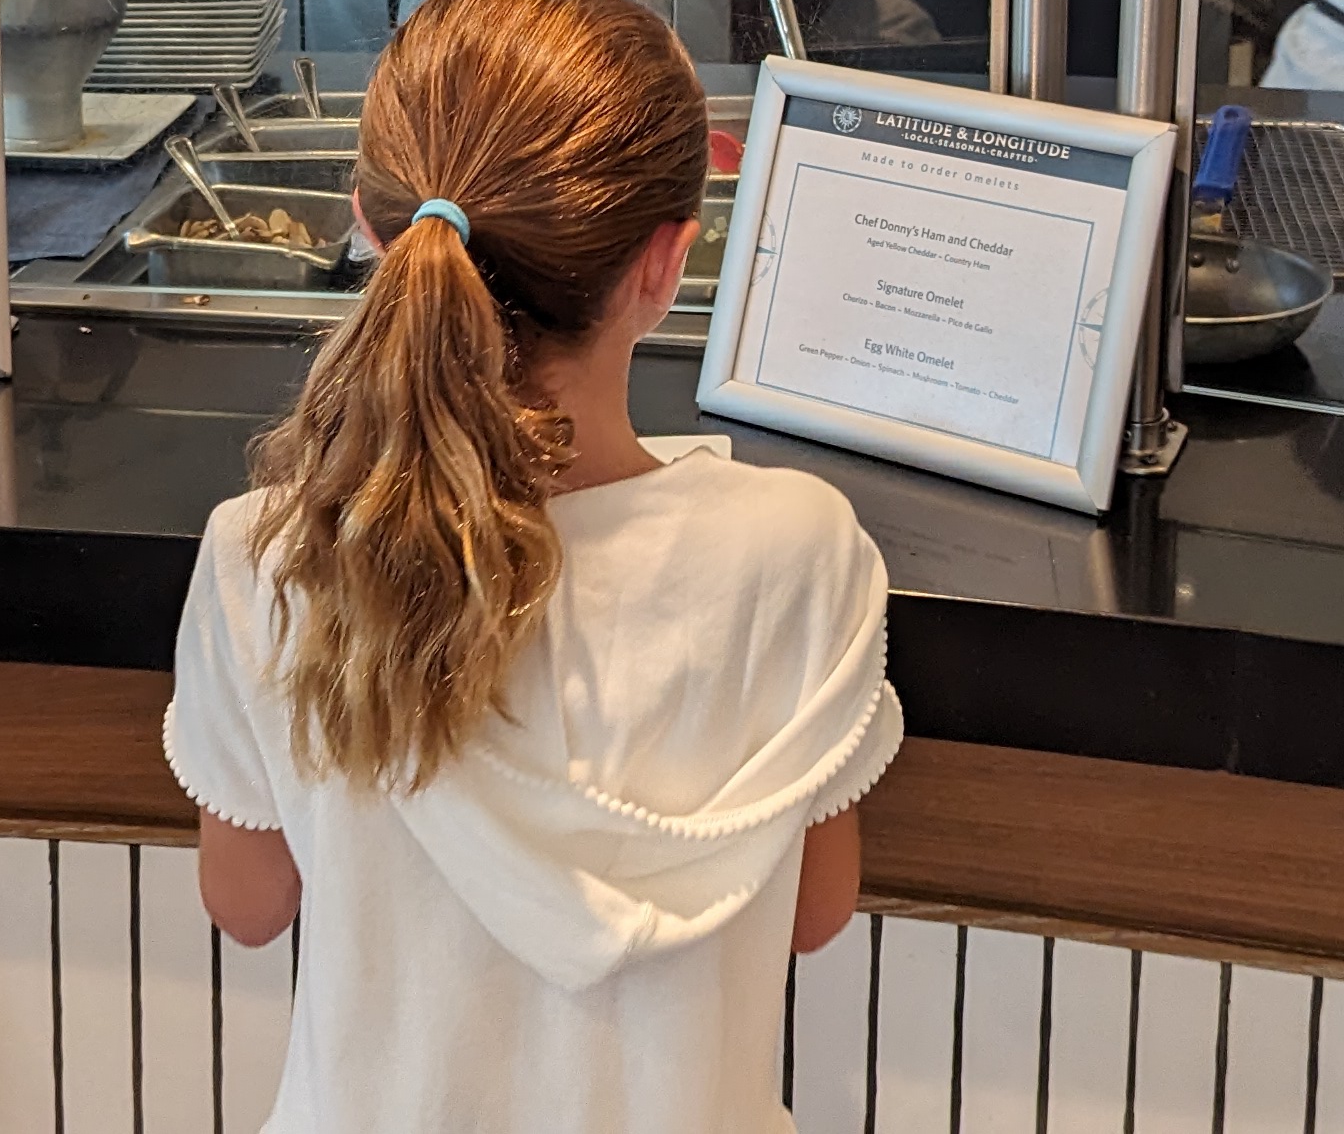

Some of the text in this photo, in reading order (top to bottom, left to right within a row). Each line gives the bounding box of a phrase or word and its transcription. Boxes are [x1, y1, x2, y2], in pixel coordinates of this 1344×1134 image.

[875, 111, 1071, 160] LATITUDE & LONGITUDE
[861, 151, 1020, 191] Made to Order Omelets
[854, 213, 1014, 257] Chef Donny's Ham and Cheddar
[866, 237, 885, 249] Aged
[885, 240, 907, 253] Yellow
[908, 245, 937, 259] Cheddar
[944, 253, 972, 268] Country
[972, 260, 991, 271] Ham
[842, 292, 868, 306] Chorizo
[875, 300, 896, 312] Bacon
[903, 307, 941, 323] Mozzarella
[947, 316, 963, 328] Pico
[963, 320, 973, 330] de
[974, 323, 993, 335] Gallo
[876, 279, 965, 310] Signature Omelet
[798, 343, 819, 355] Green
[819, 348, 844, 362] Pepper
[850, 356, 871, 368] Onion
[878, 363, 905, 377] Spinach
[912, 371, 949, 387] Mushroom
[988, 390, 1019, 405] Cheddar
[864, 337, 955, 370] Egg White Omelet
